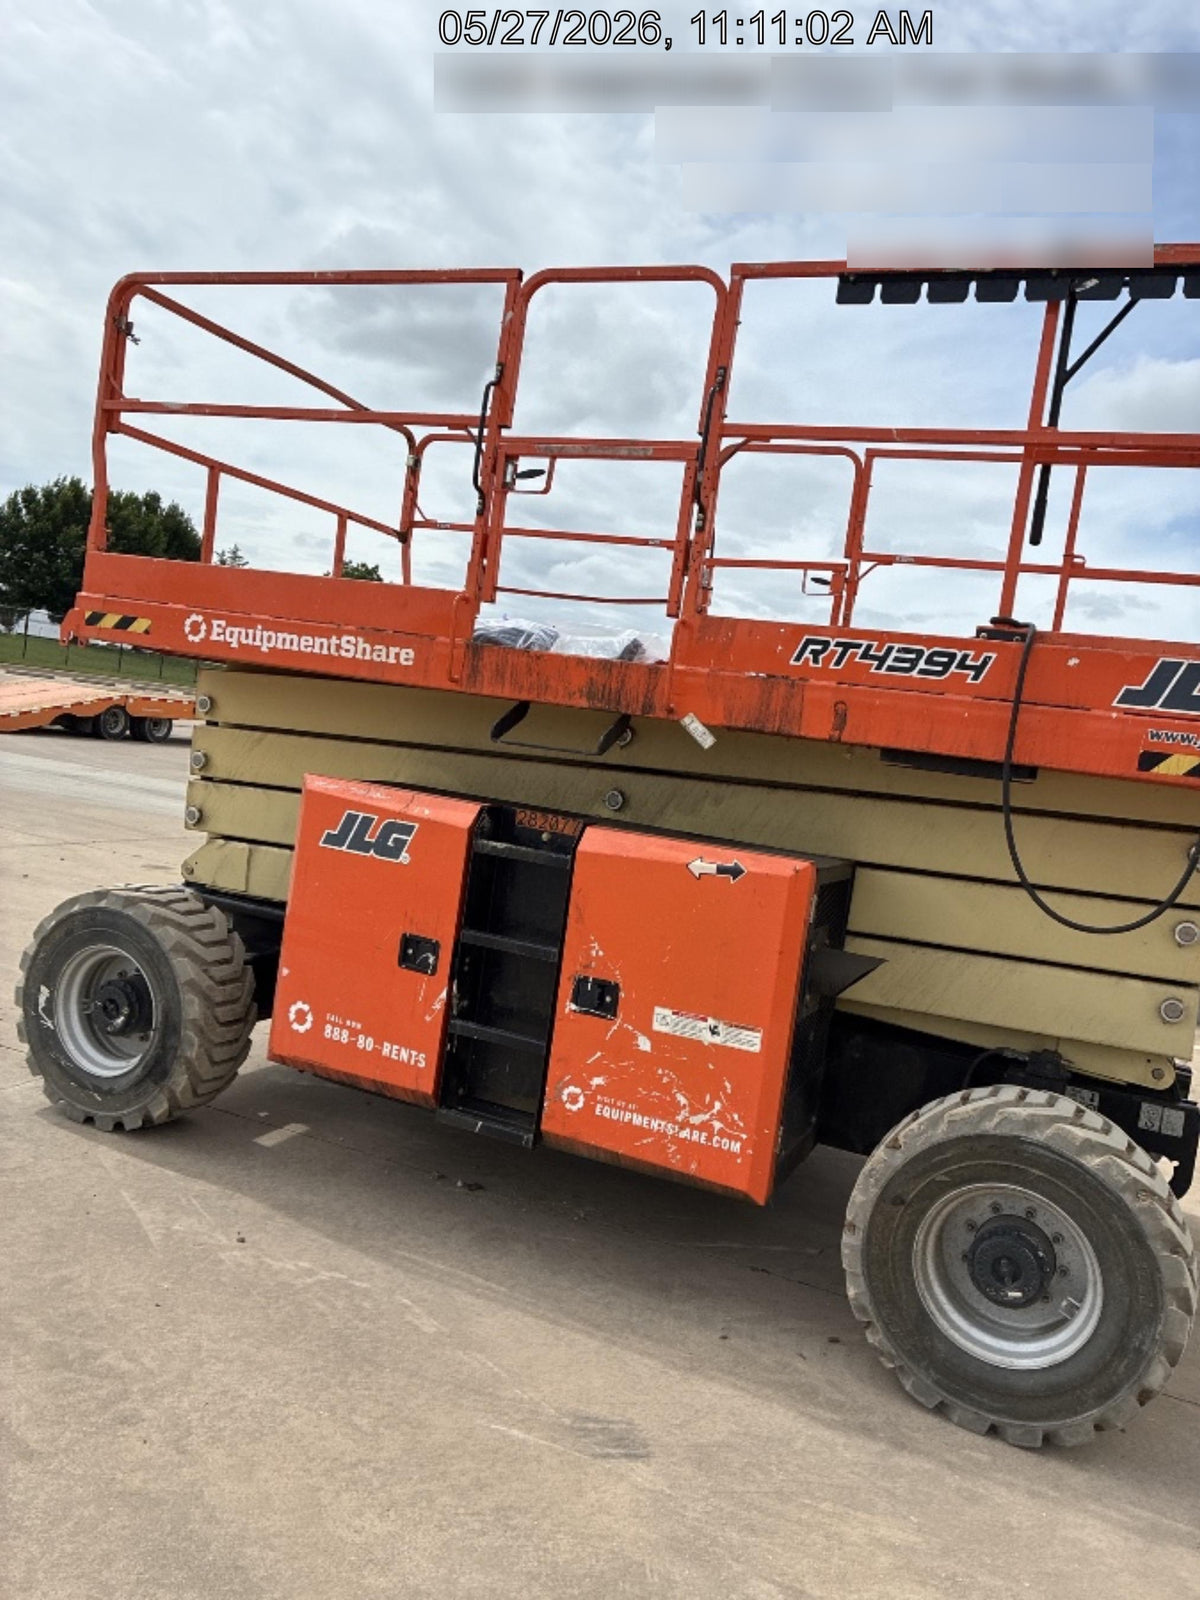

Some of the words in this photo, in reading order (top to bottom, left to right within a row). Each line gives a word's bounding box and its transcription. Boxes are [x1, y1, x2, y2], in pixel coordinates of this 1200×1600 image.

[210, 619, 414, 666] EquipmentShare
[789, 635, 997, 684] RT4394
[1111, 657, 1200, 715] JL
[1148, 729, 1200, 750] www.
[319, 810, 419, 863] JLG
[324, 1023, 426, 1068] 888-80-RENTS
